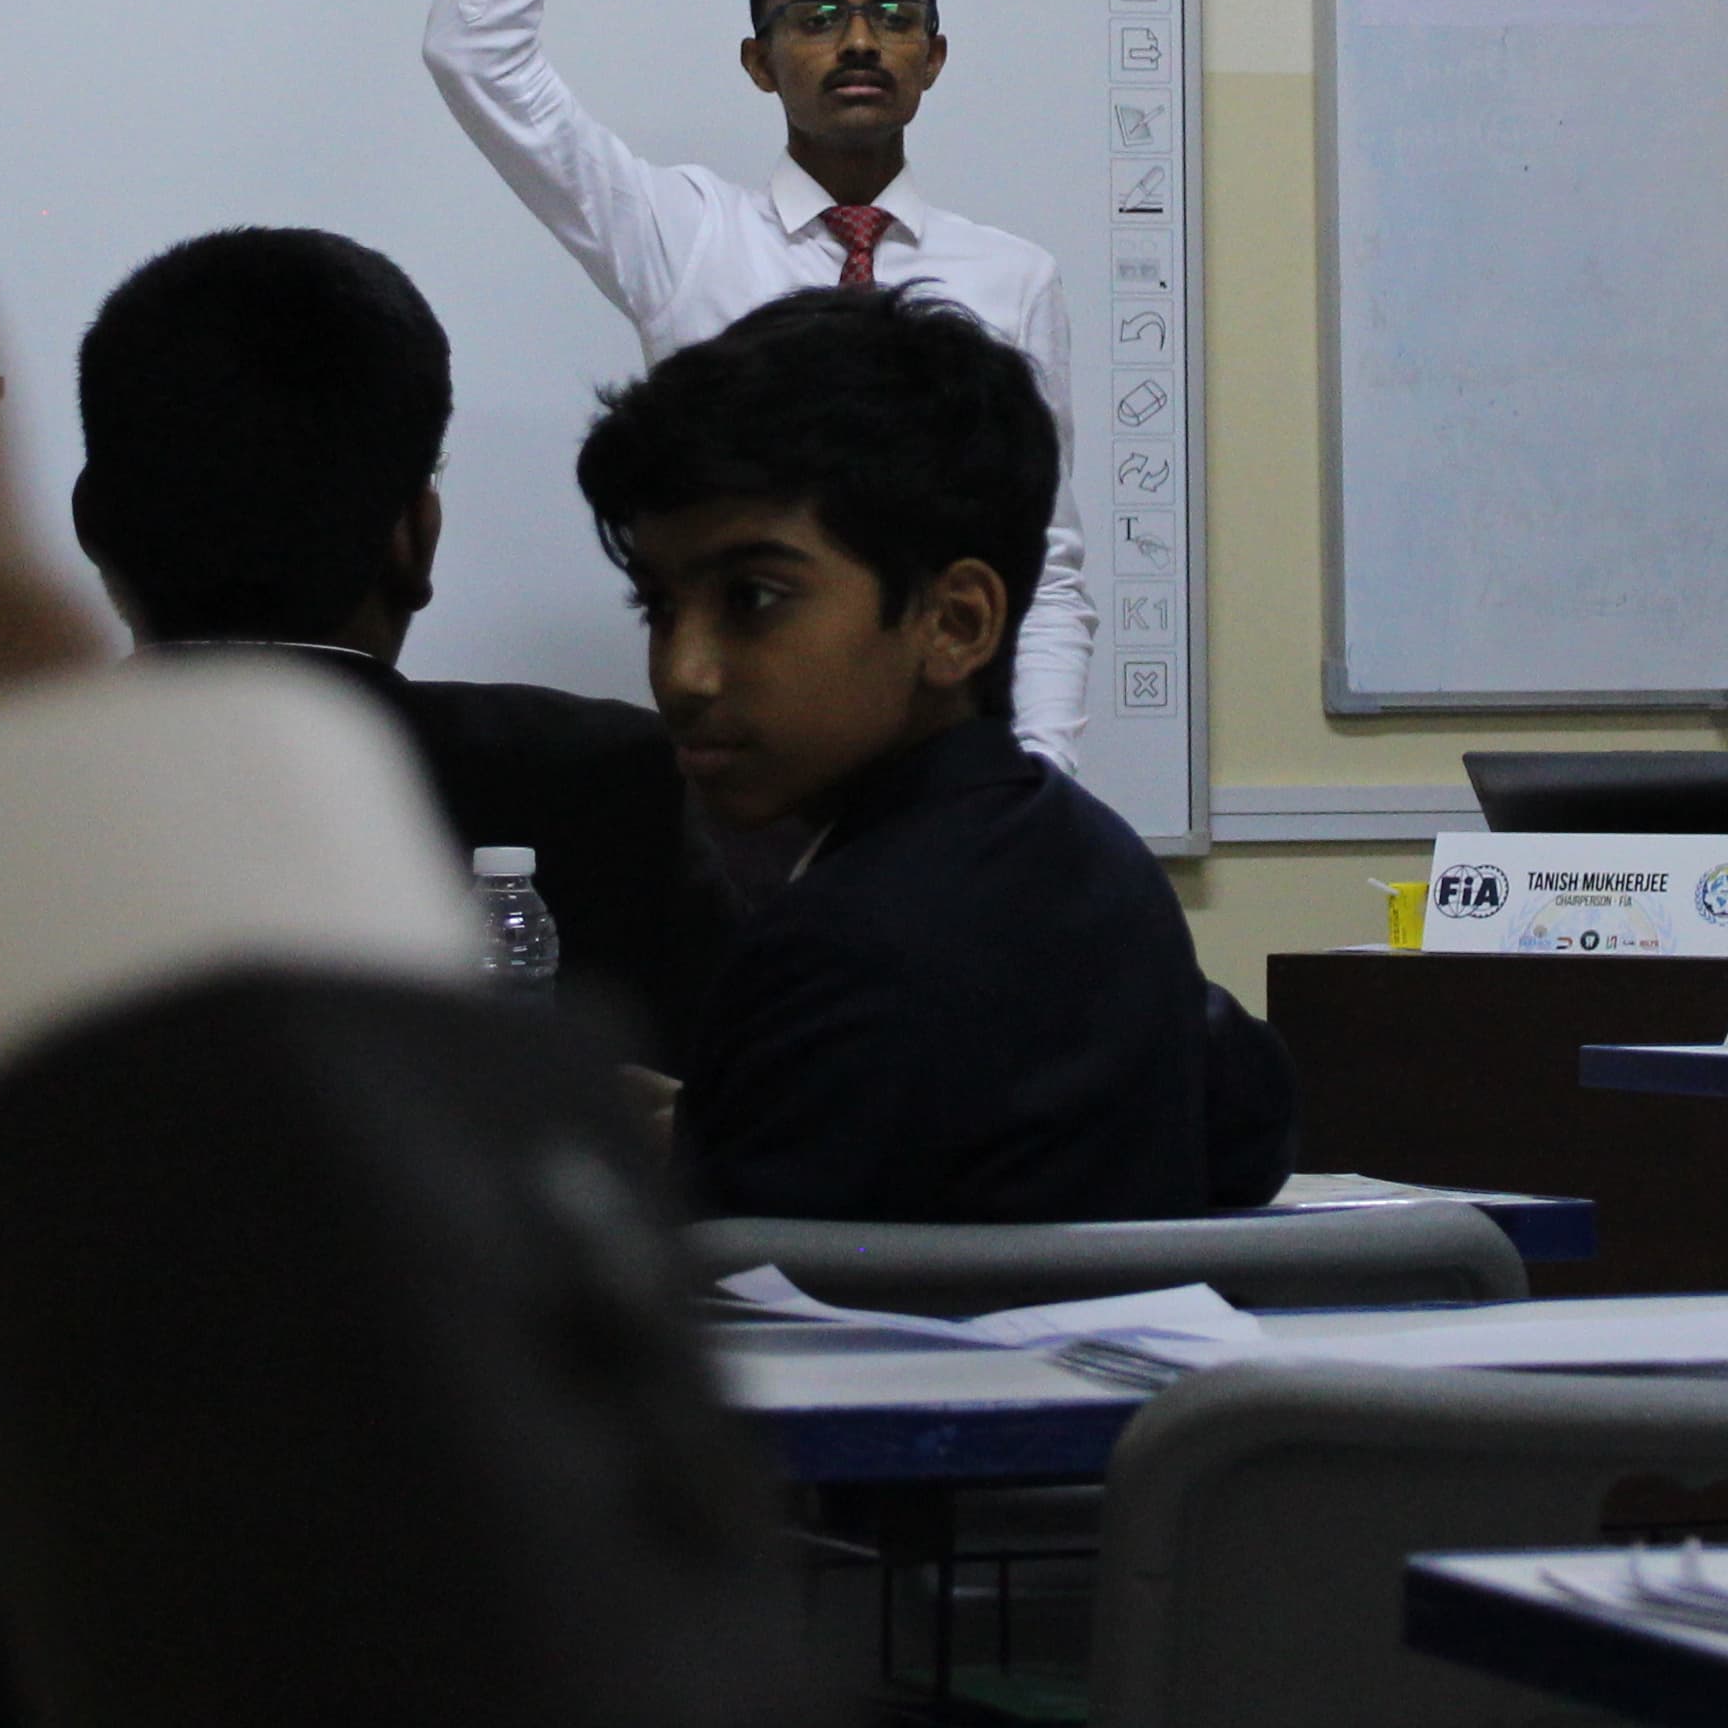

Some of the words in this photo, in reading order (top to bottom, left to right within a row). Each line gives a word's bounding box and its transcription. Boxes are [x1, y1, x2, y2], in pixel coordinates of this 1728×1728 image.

[1527, 871, 1578, 892] TANISH
[1582, 872, 1669, 893] MUKHERJEE
[1555, 894, 1612, 907] CHAIRPERSON
